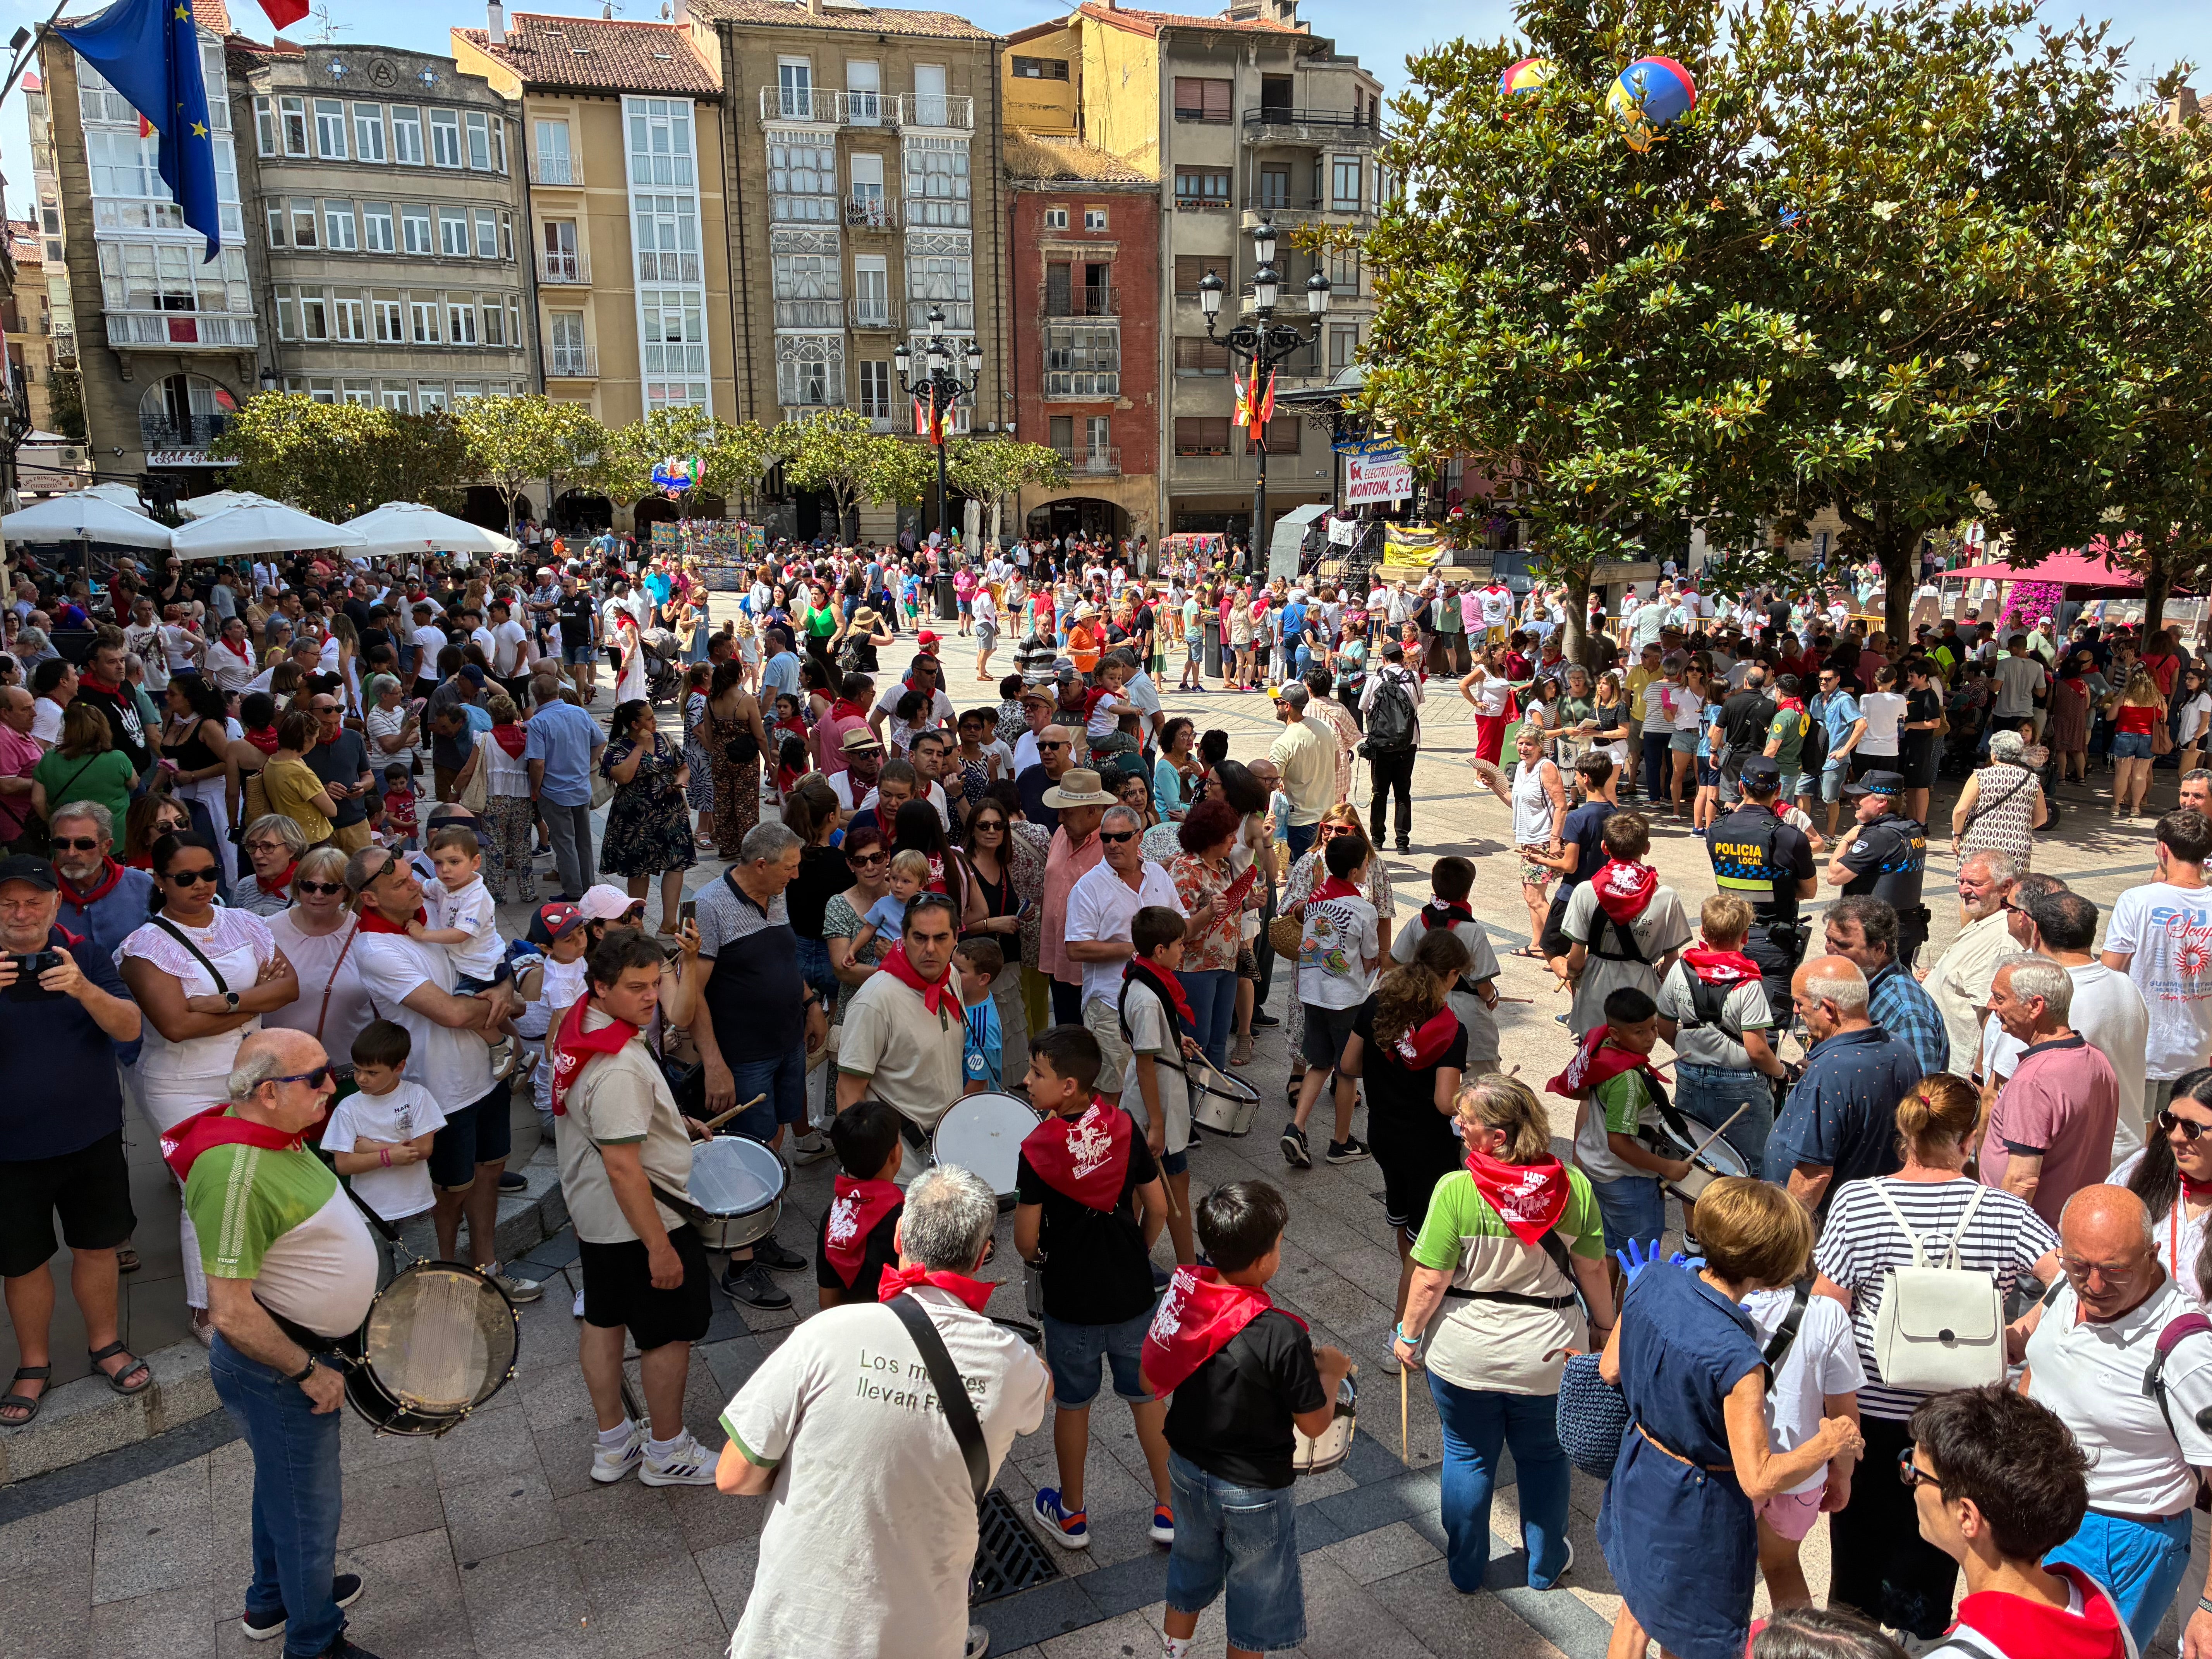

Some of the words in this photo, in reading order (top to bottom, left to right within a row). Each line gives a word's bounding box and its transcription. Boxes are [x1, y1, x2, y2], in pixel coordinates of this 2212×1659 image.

[1364, 465, 1411, 479] ELECTRICIDAD
[1349, 479, 1391, 498] MONTOYA,
[1395, 477, 1411, 493] S.L.
[1715, 842, 1762, 857] POLICIA
[1738, 857, 1762, 866] LOCAL
[1631, 917, 1653, 926] ores
[2152, 907, 2207, 927] SU
[1632, 929, 1651, 938] ndt.
[1674, 981, 1690, 992] Los
[1673, 993, 1693, 1007] lleva
[970, 1054, 982, 1070] hp
[394, 1104, 409, 1113] HAR
[1523, 1170, 1549, 1187] HAR
[860, 1349, 899, 1373] Los
[908, 1363, 986, 1394] mres
[856, 1376, 917, 1409] llevan
